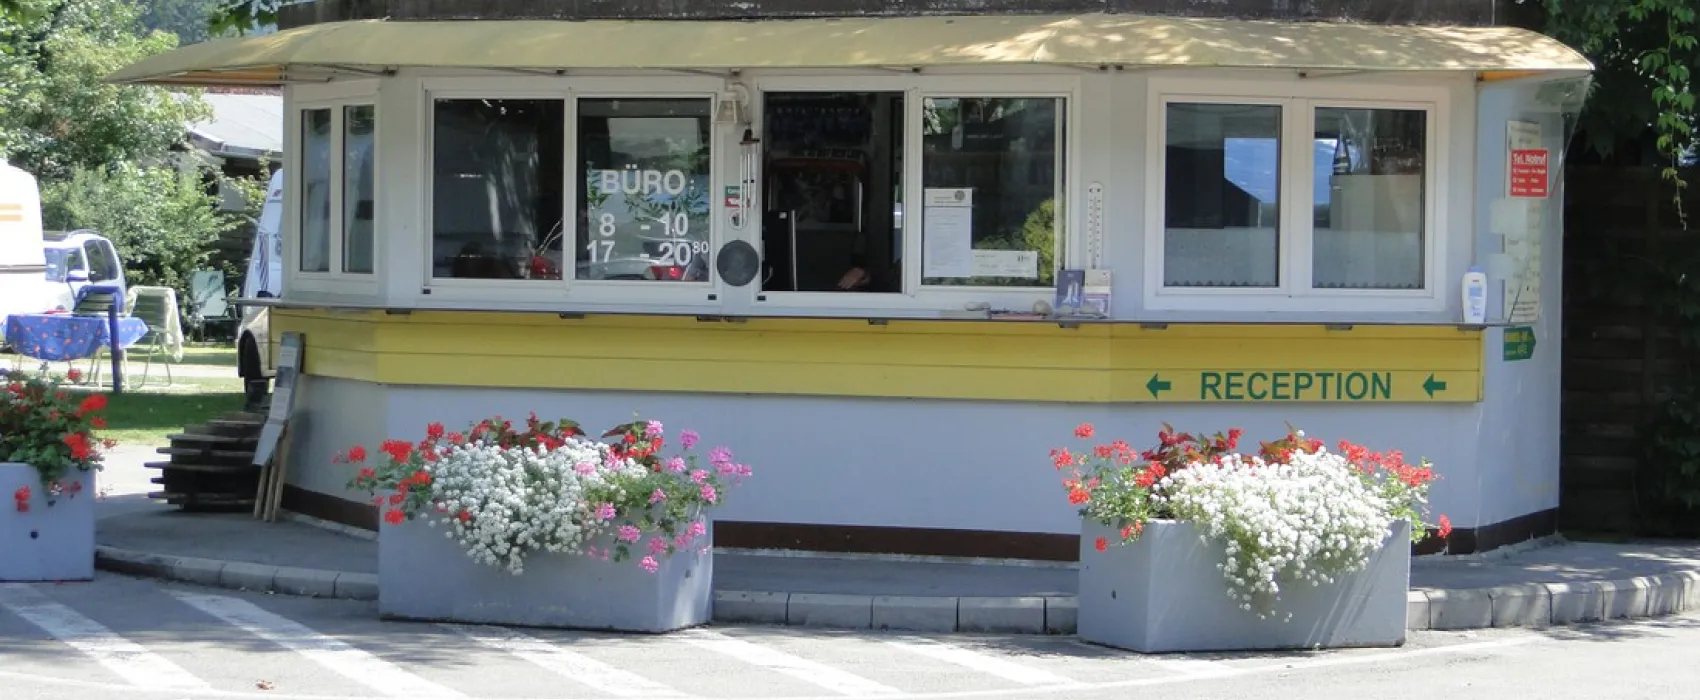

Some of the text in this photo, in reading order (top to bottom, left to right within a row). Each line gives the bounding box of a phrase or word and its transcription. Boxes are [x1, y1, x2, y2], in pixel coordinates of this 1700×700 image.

[599, 213, 616, 237] 8
[660, 211, 689, 236] 10
[586, 240, 616, 264] 17
[1199, 371, 1392, 400] RECEPTION
